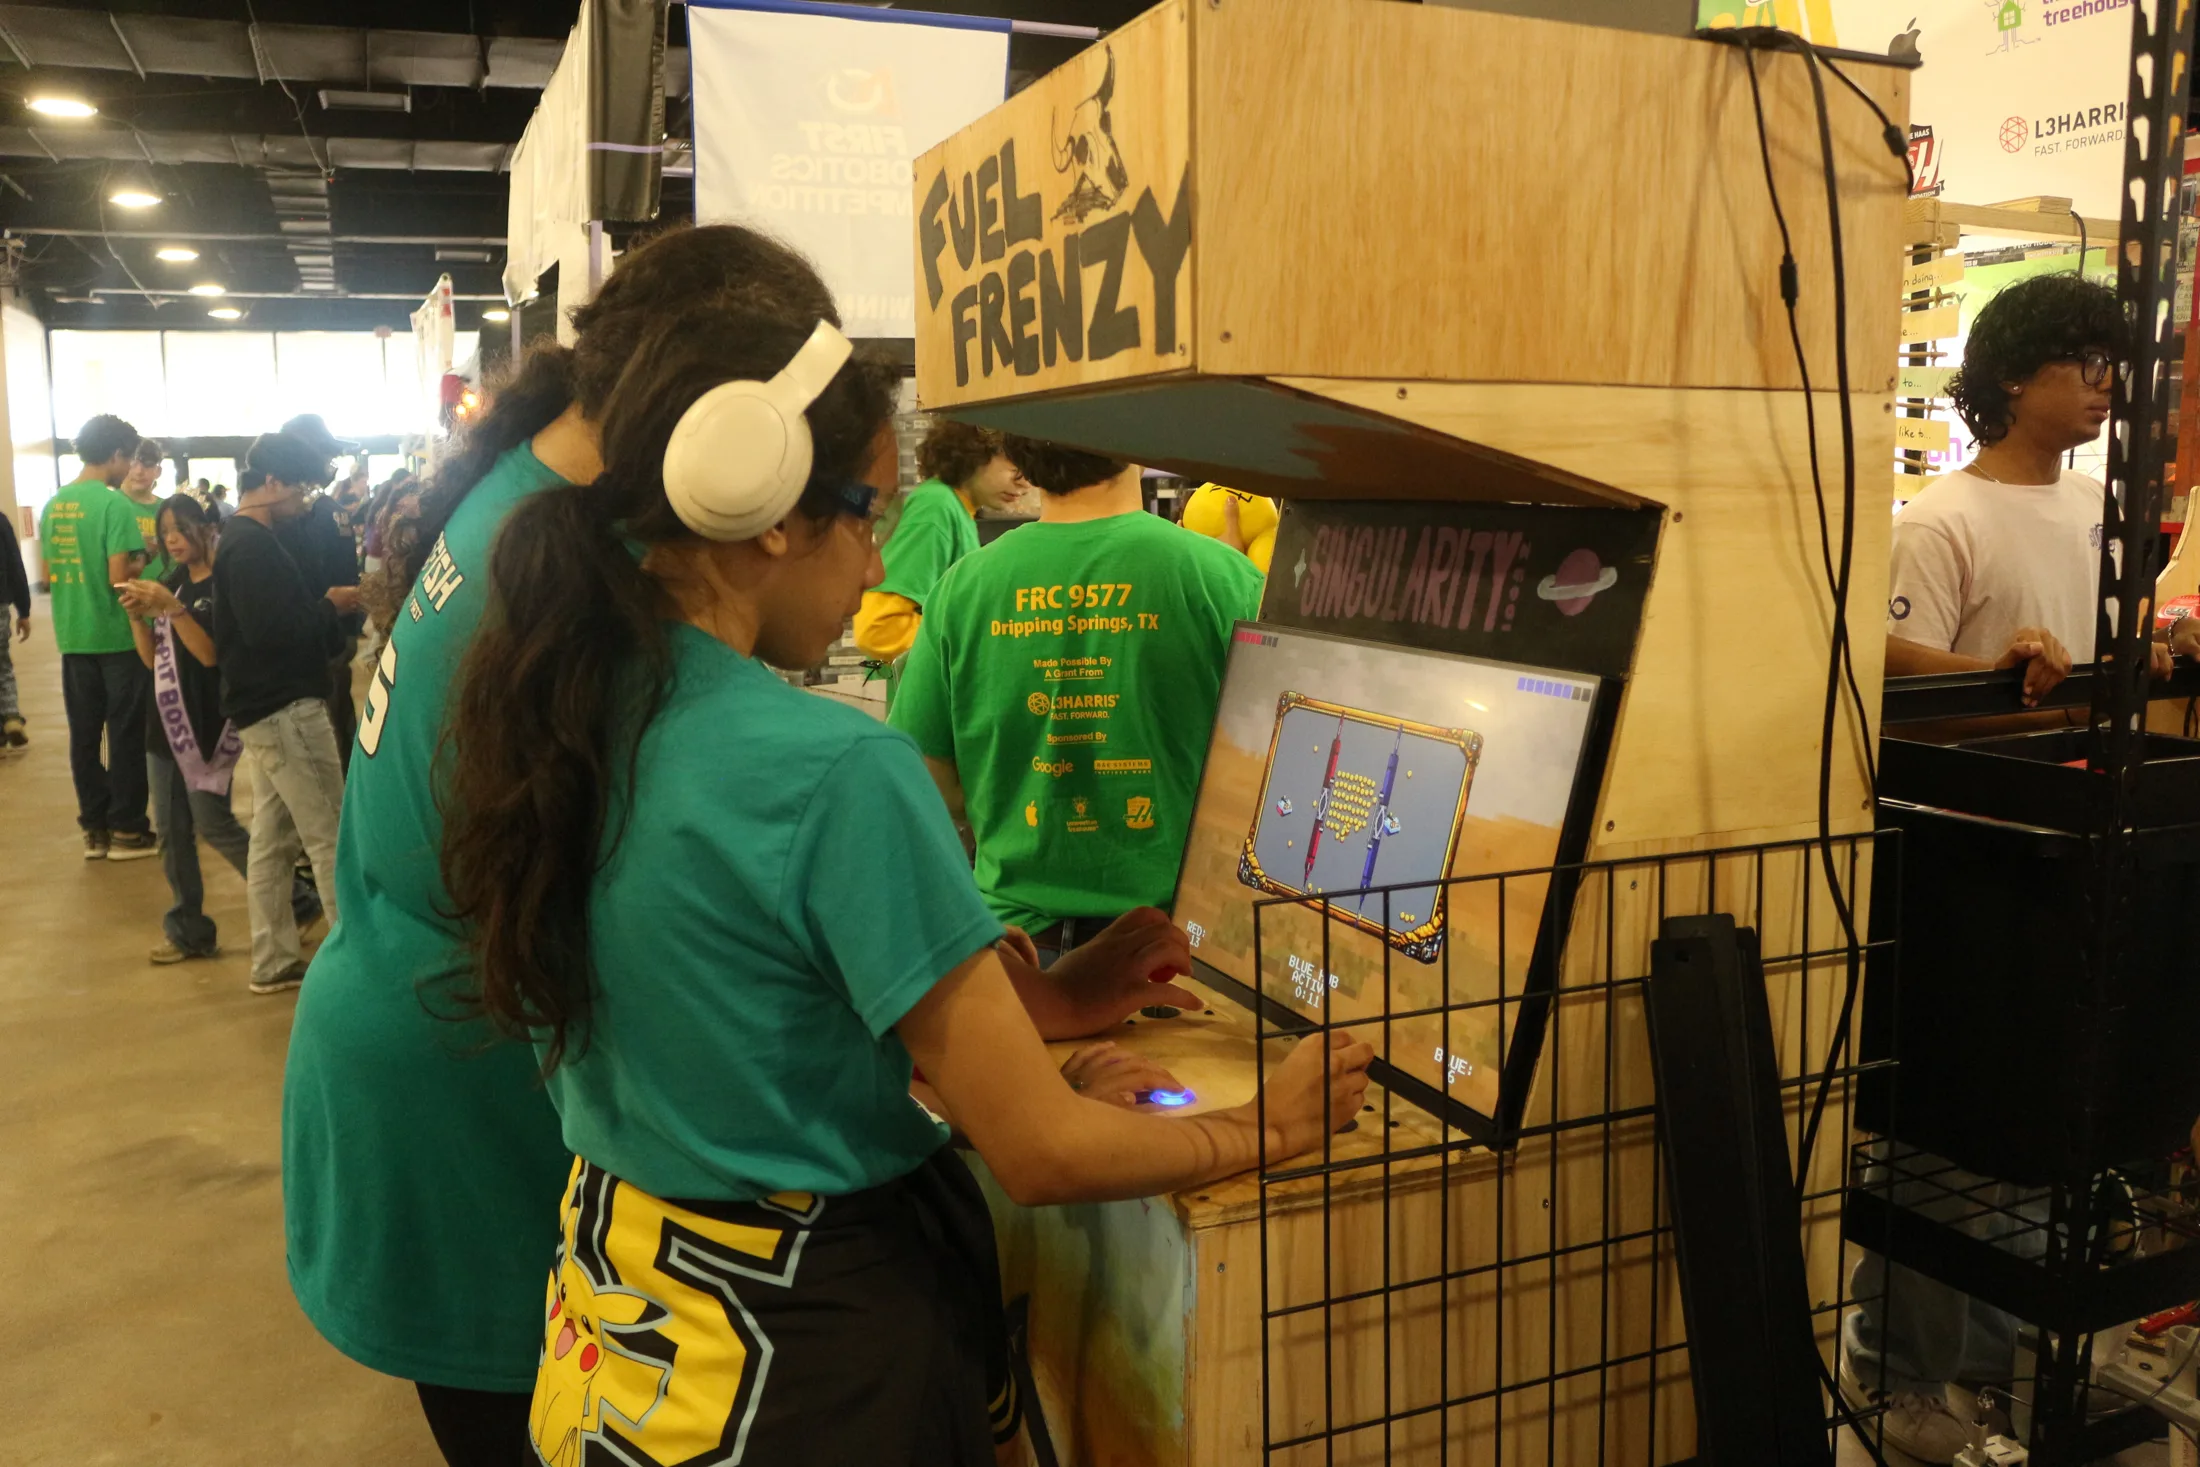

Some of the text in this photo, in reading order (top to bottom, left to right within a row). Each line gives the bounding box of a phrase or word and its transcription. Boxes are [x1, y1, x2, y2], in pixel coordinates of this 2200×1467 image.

[2043, 0, 2135, 27] treehous
[2035, 101, 2130, 139] L3HARRI
[2034, 128, 2126, 157] FAST. FORWARD.
[918, 137, 1044, 313] FUEL
[950, 160, 1191, 388] FRENZY
[1015, 583, 1132, 612] FRC 9577
[991, 613, 1160, 638] Dripping Springs, TX
[1033, 655, 1112, 669] Made Possible By
[1045, 669, 1052, 678] A
[1079, 667, 1104, 677] From
[1051, 694, 1118, 709] L3HARRIS
[158, 689, 195, 755] BOSS
[1070, 710, 1110, 720] FORWARD.
[1047, 731, 1107, 744] Sponsored By
[1032, 756, 1074, 777] Google
[1186, 920, 1207, 938] RED:
[1189, 936, 1201, 948] 13
[1288, 954, 1315, 976] BLUE
[1291, 970, 1326, 997] ACTIV
[1434, 1046, 1473, 1077] BUE:
